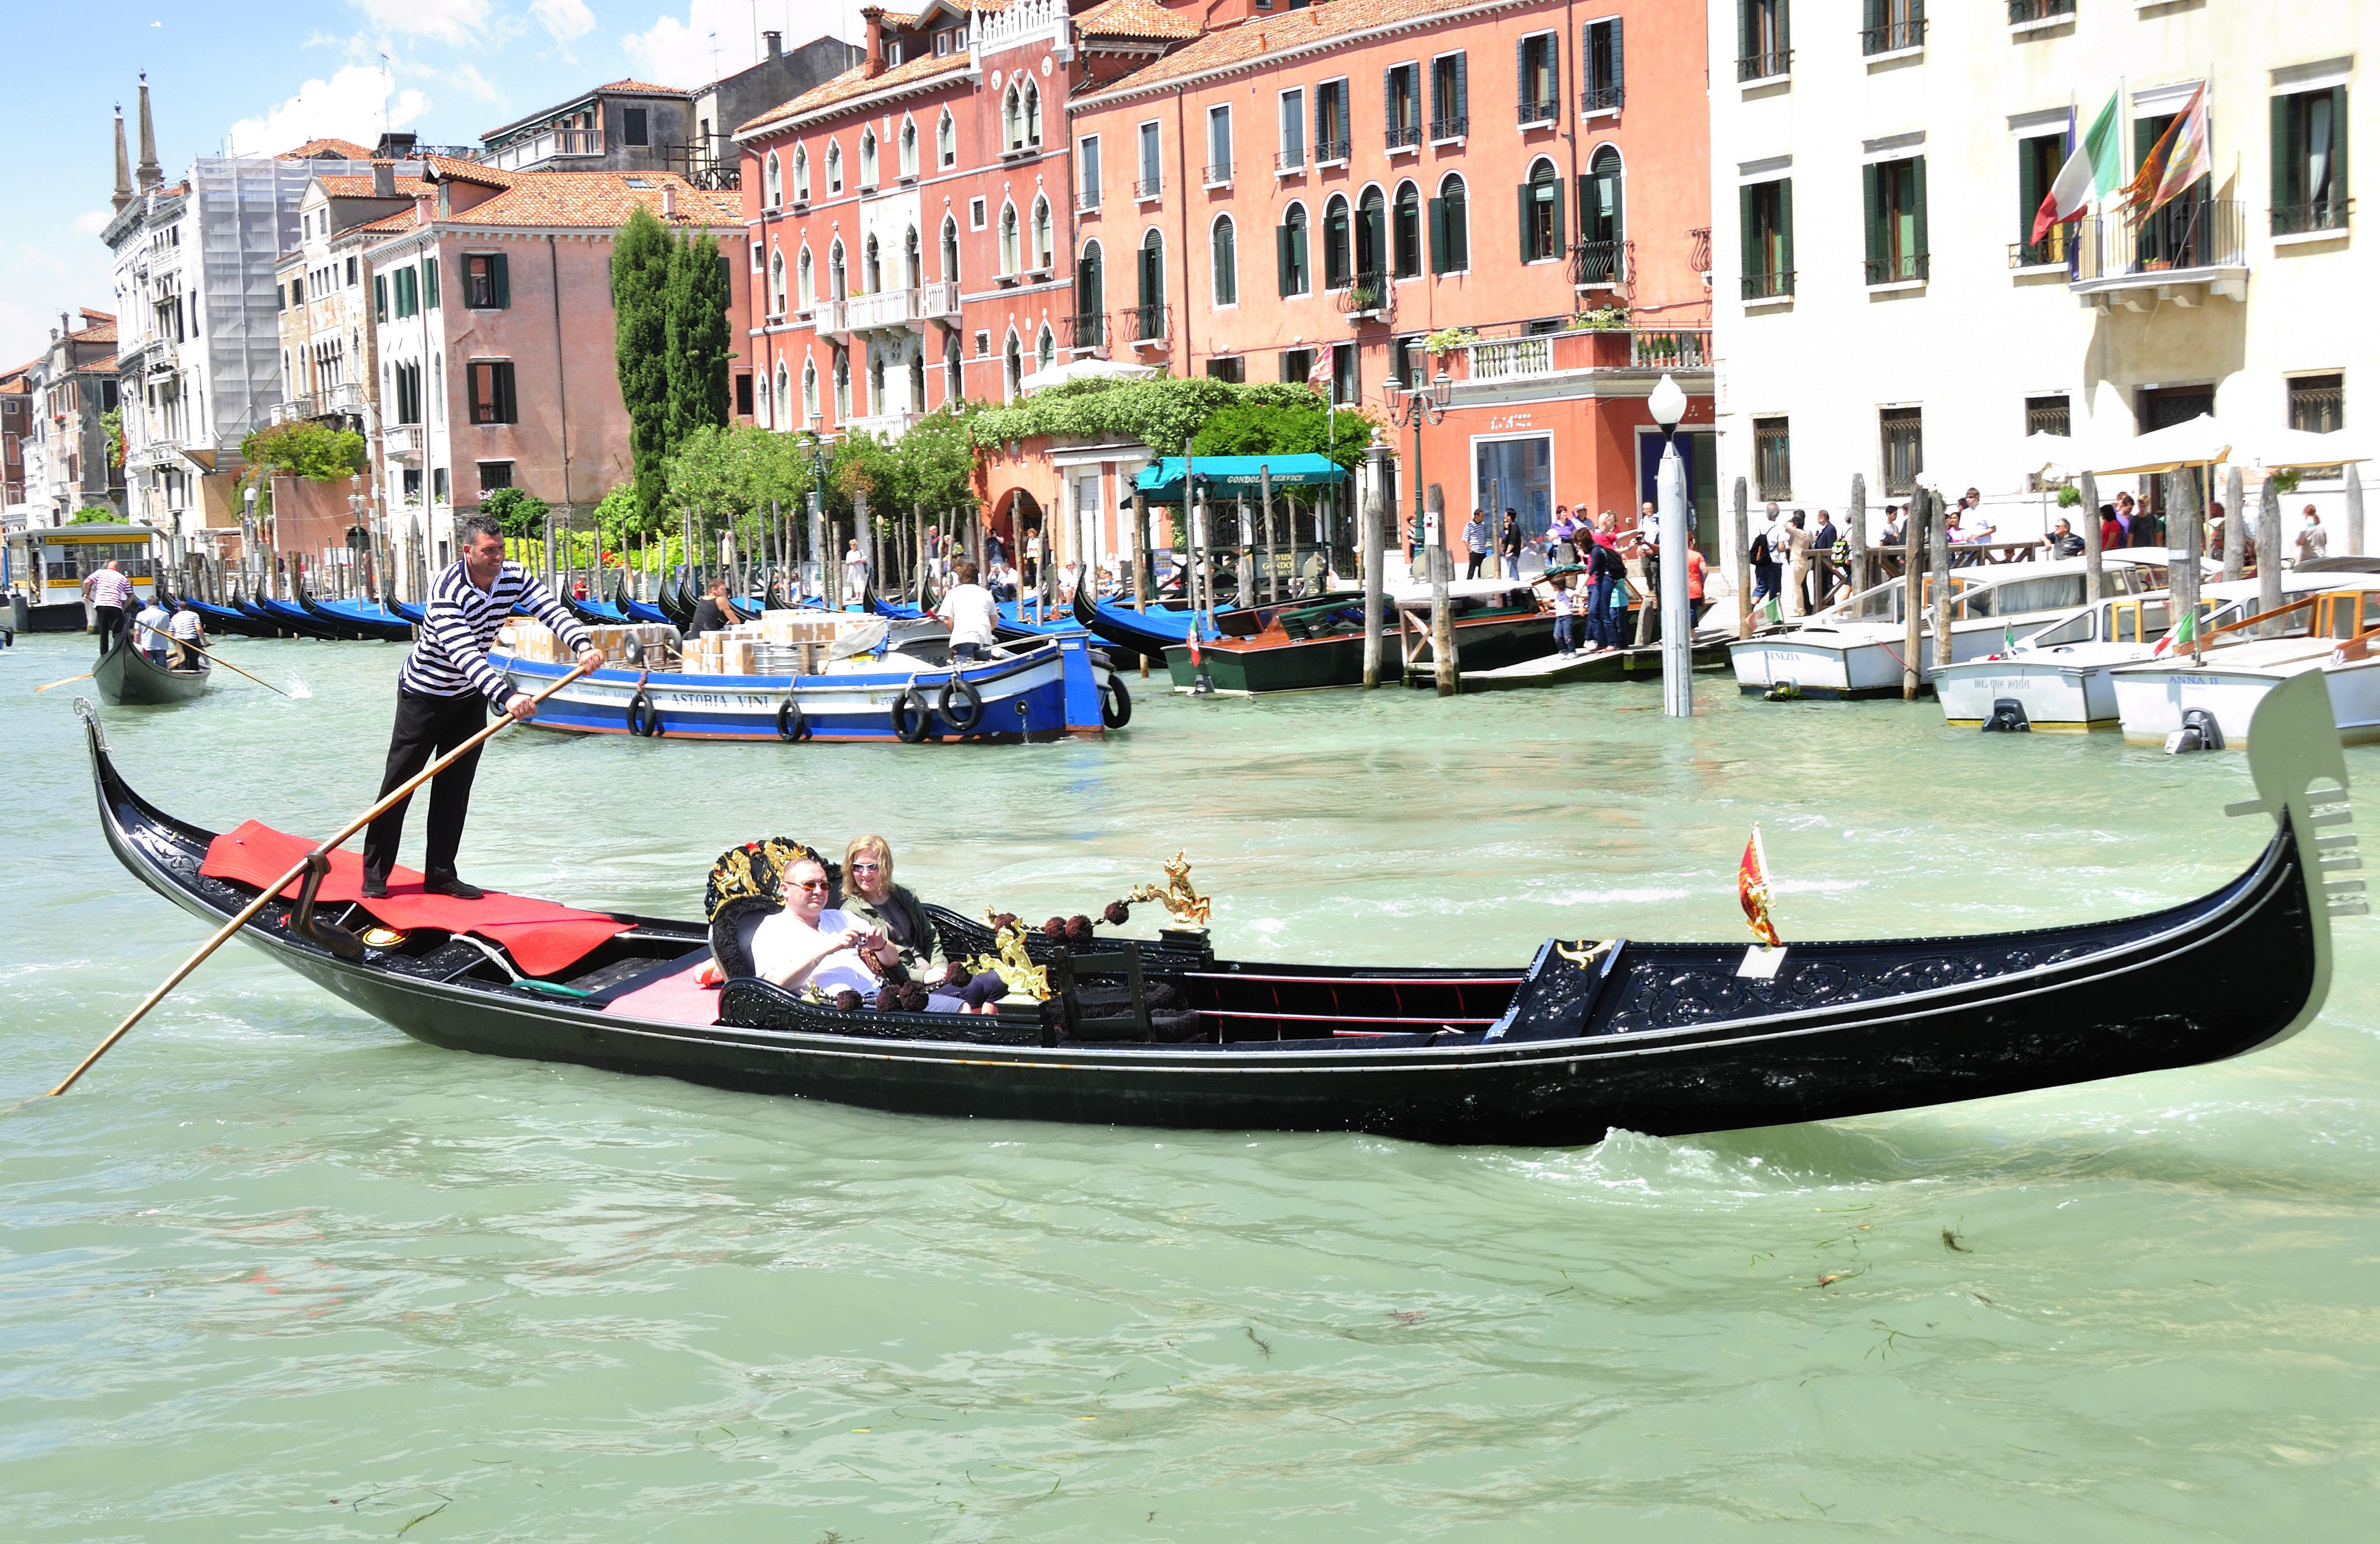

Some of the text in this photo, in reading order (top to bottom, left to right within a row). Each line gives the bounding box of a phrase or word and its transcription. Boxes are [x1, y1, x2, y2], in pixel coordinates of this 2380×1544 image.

[1227, 475, 1262, 484] GONDOL
[1765, 652, 1799, 661] VENEZIA
[1990, 679, 2004, 698] que
[2008, 669, 2030, 689] nada
[2169, 676, 2205, 684] ANNA
[672, 694, 728, 707] ASTORIA
[737, 696, 768, 708] VINI
